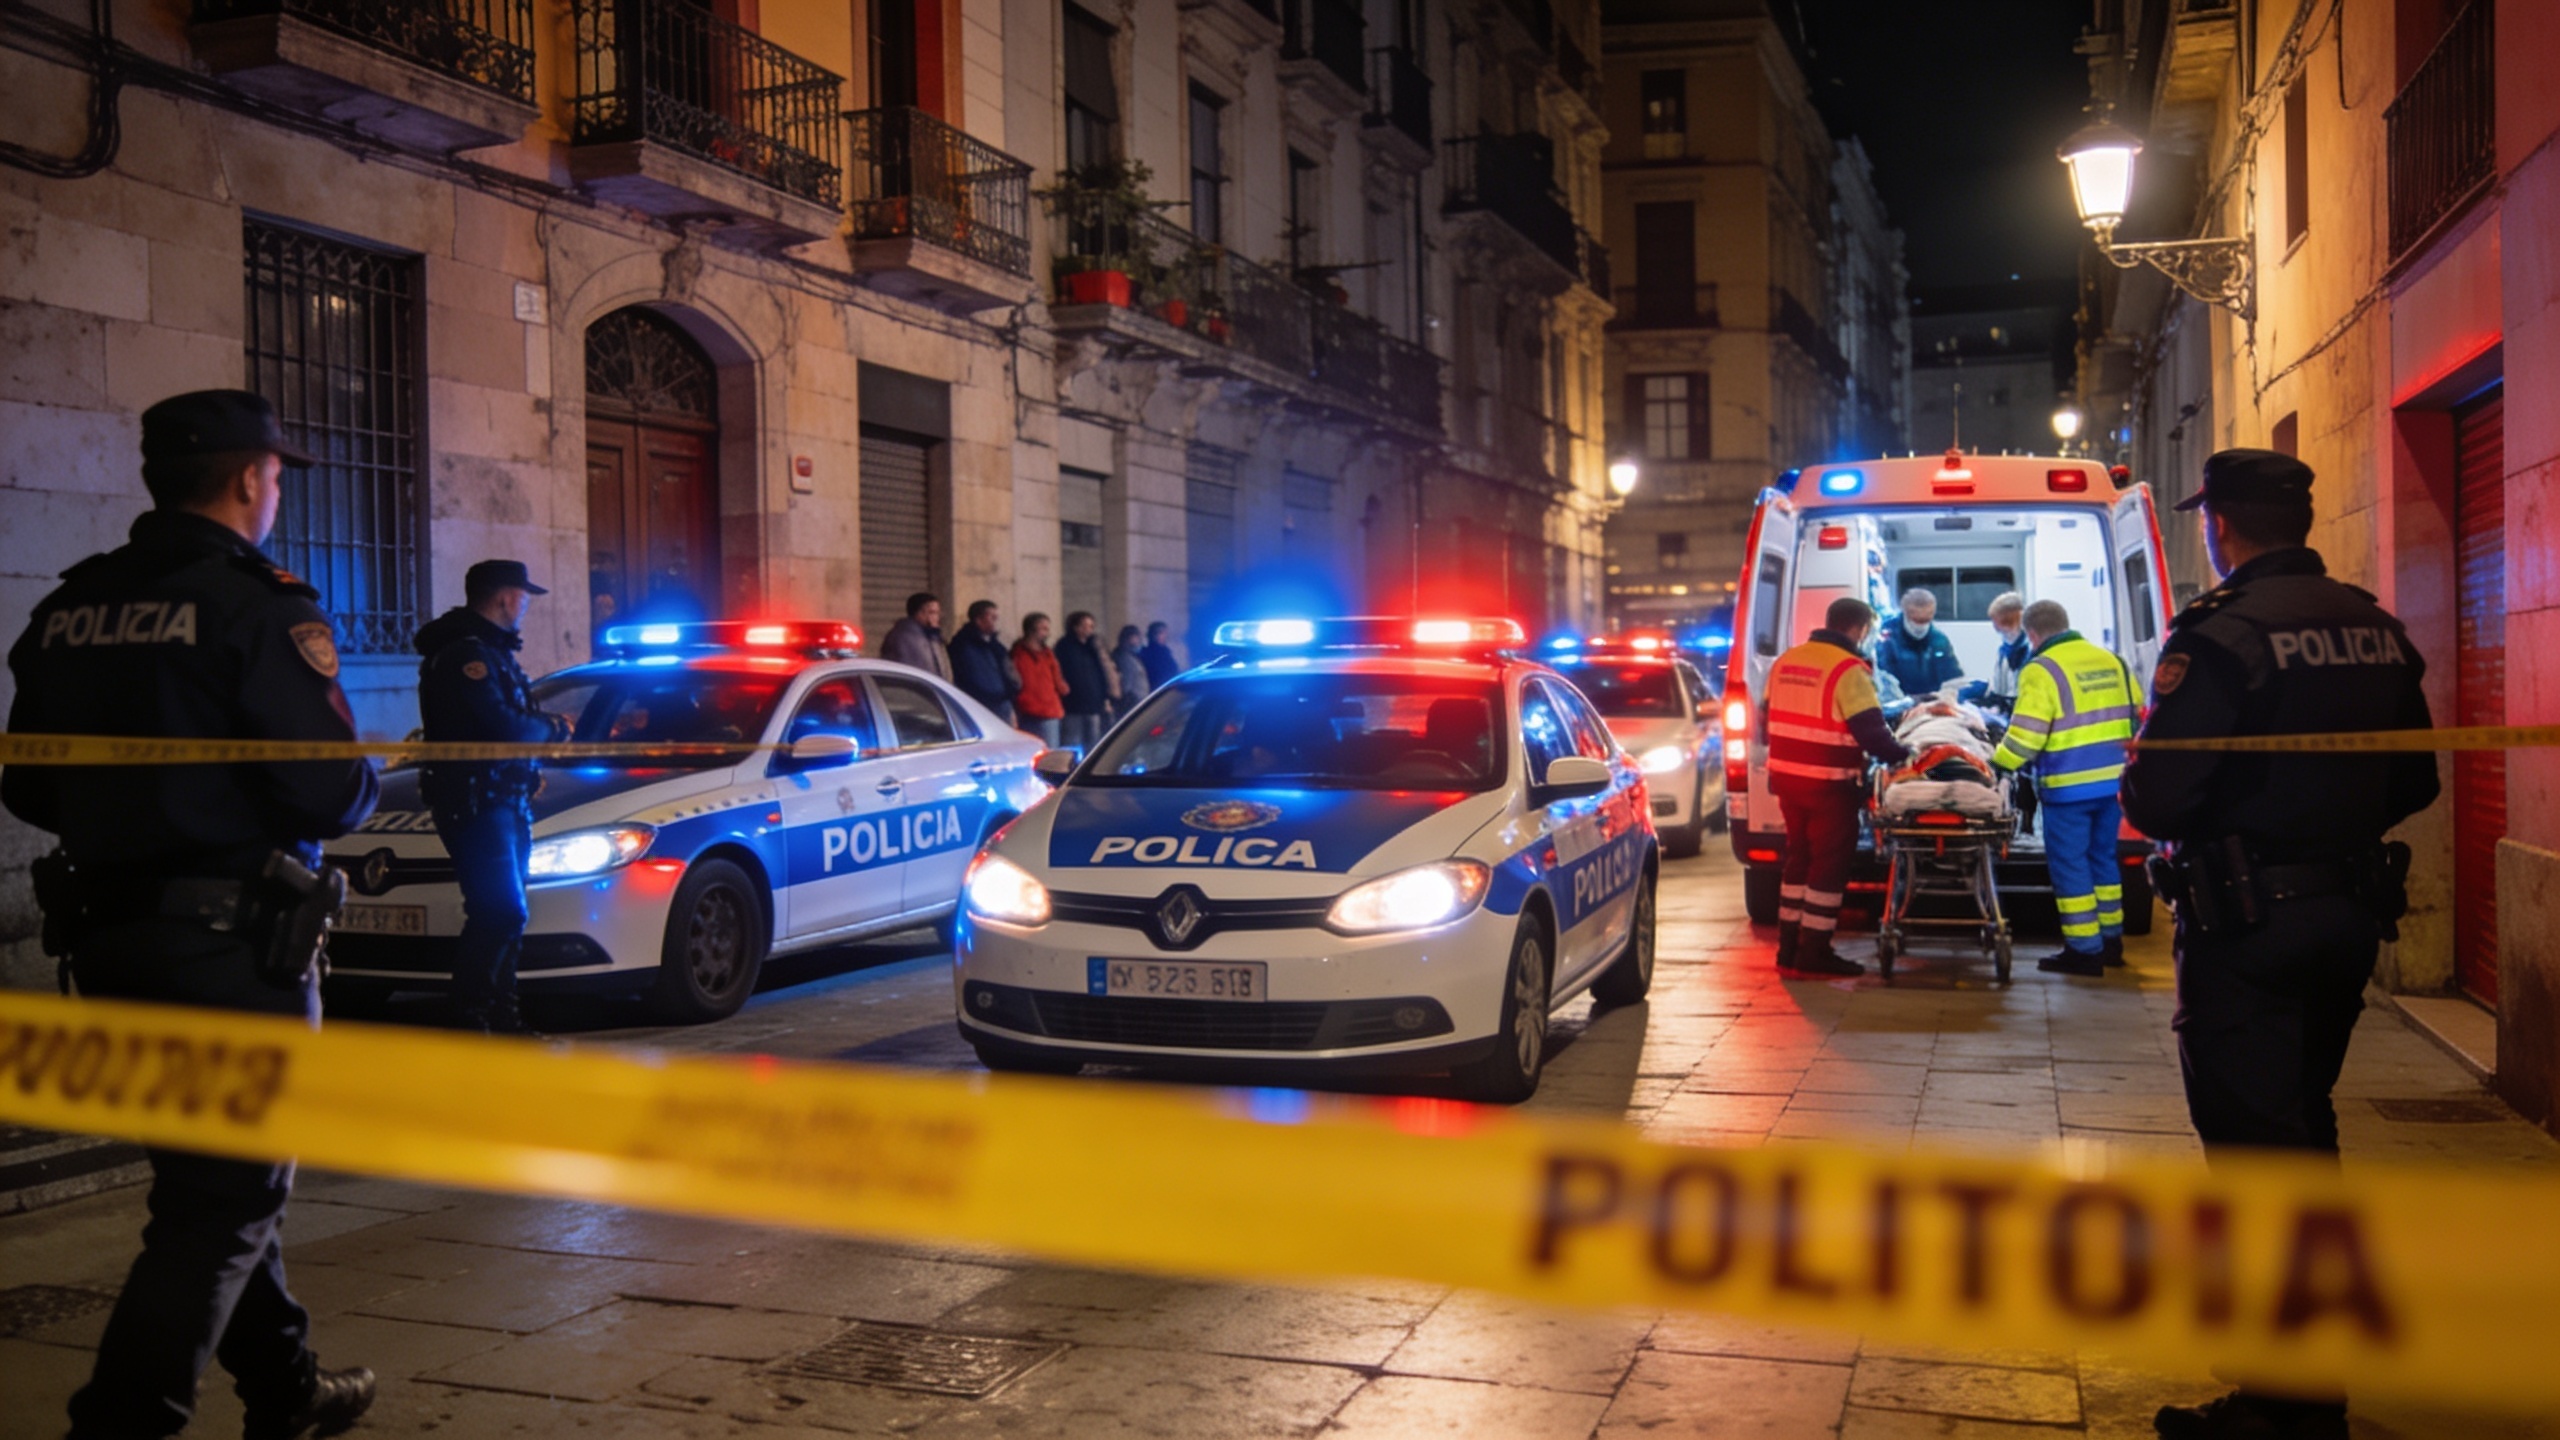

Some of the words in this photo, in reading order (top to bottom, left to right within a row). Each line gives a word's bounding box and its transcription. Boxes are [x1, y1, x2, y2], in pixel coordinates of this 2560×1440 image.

[822, 804, 962, 873] POLICIA
[1089, 835, 1317, 869] POLICA
[1522, 1153, 2402, 1342] POLITOIA
